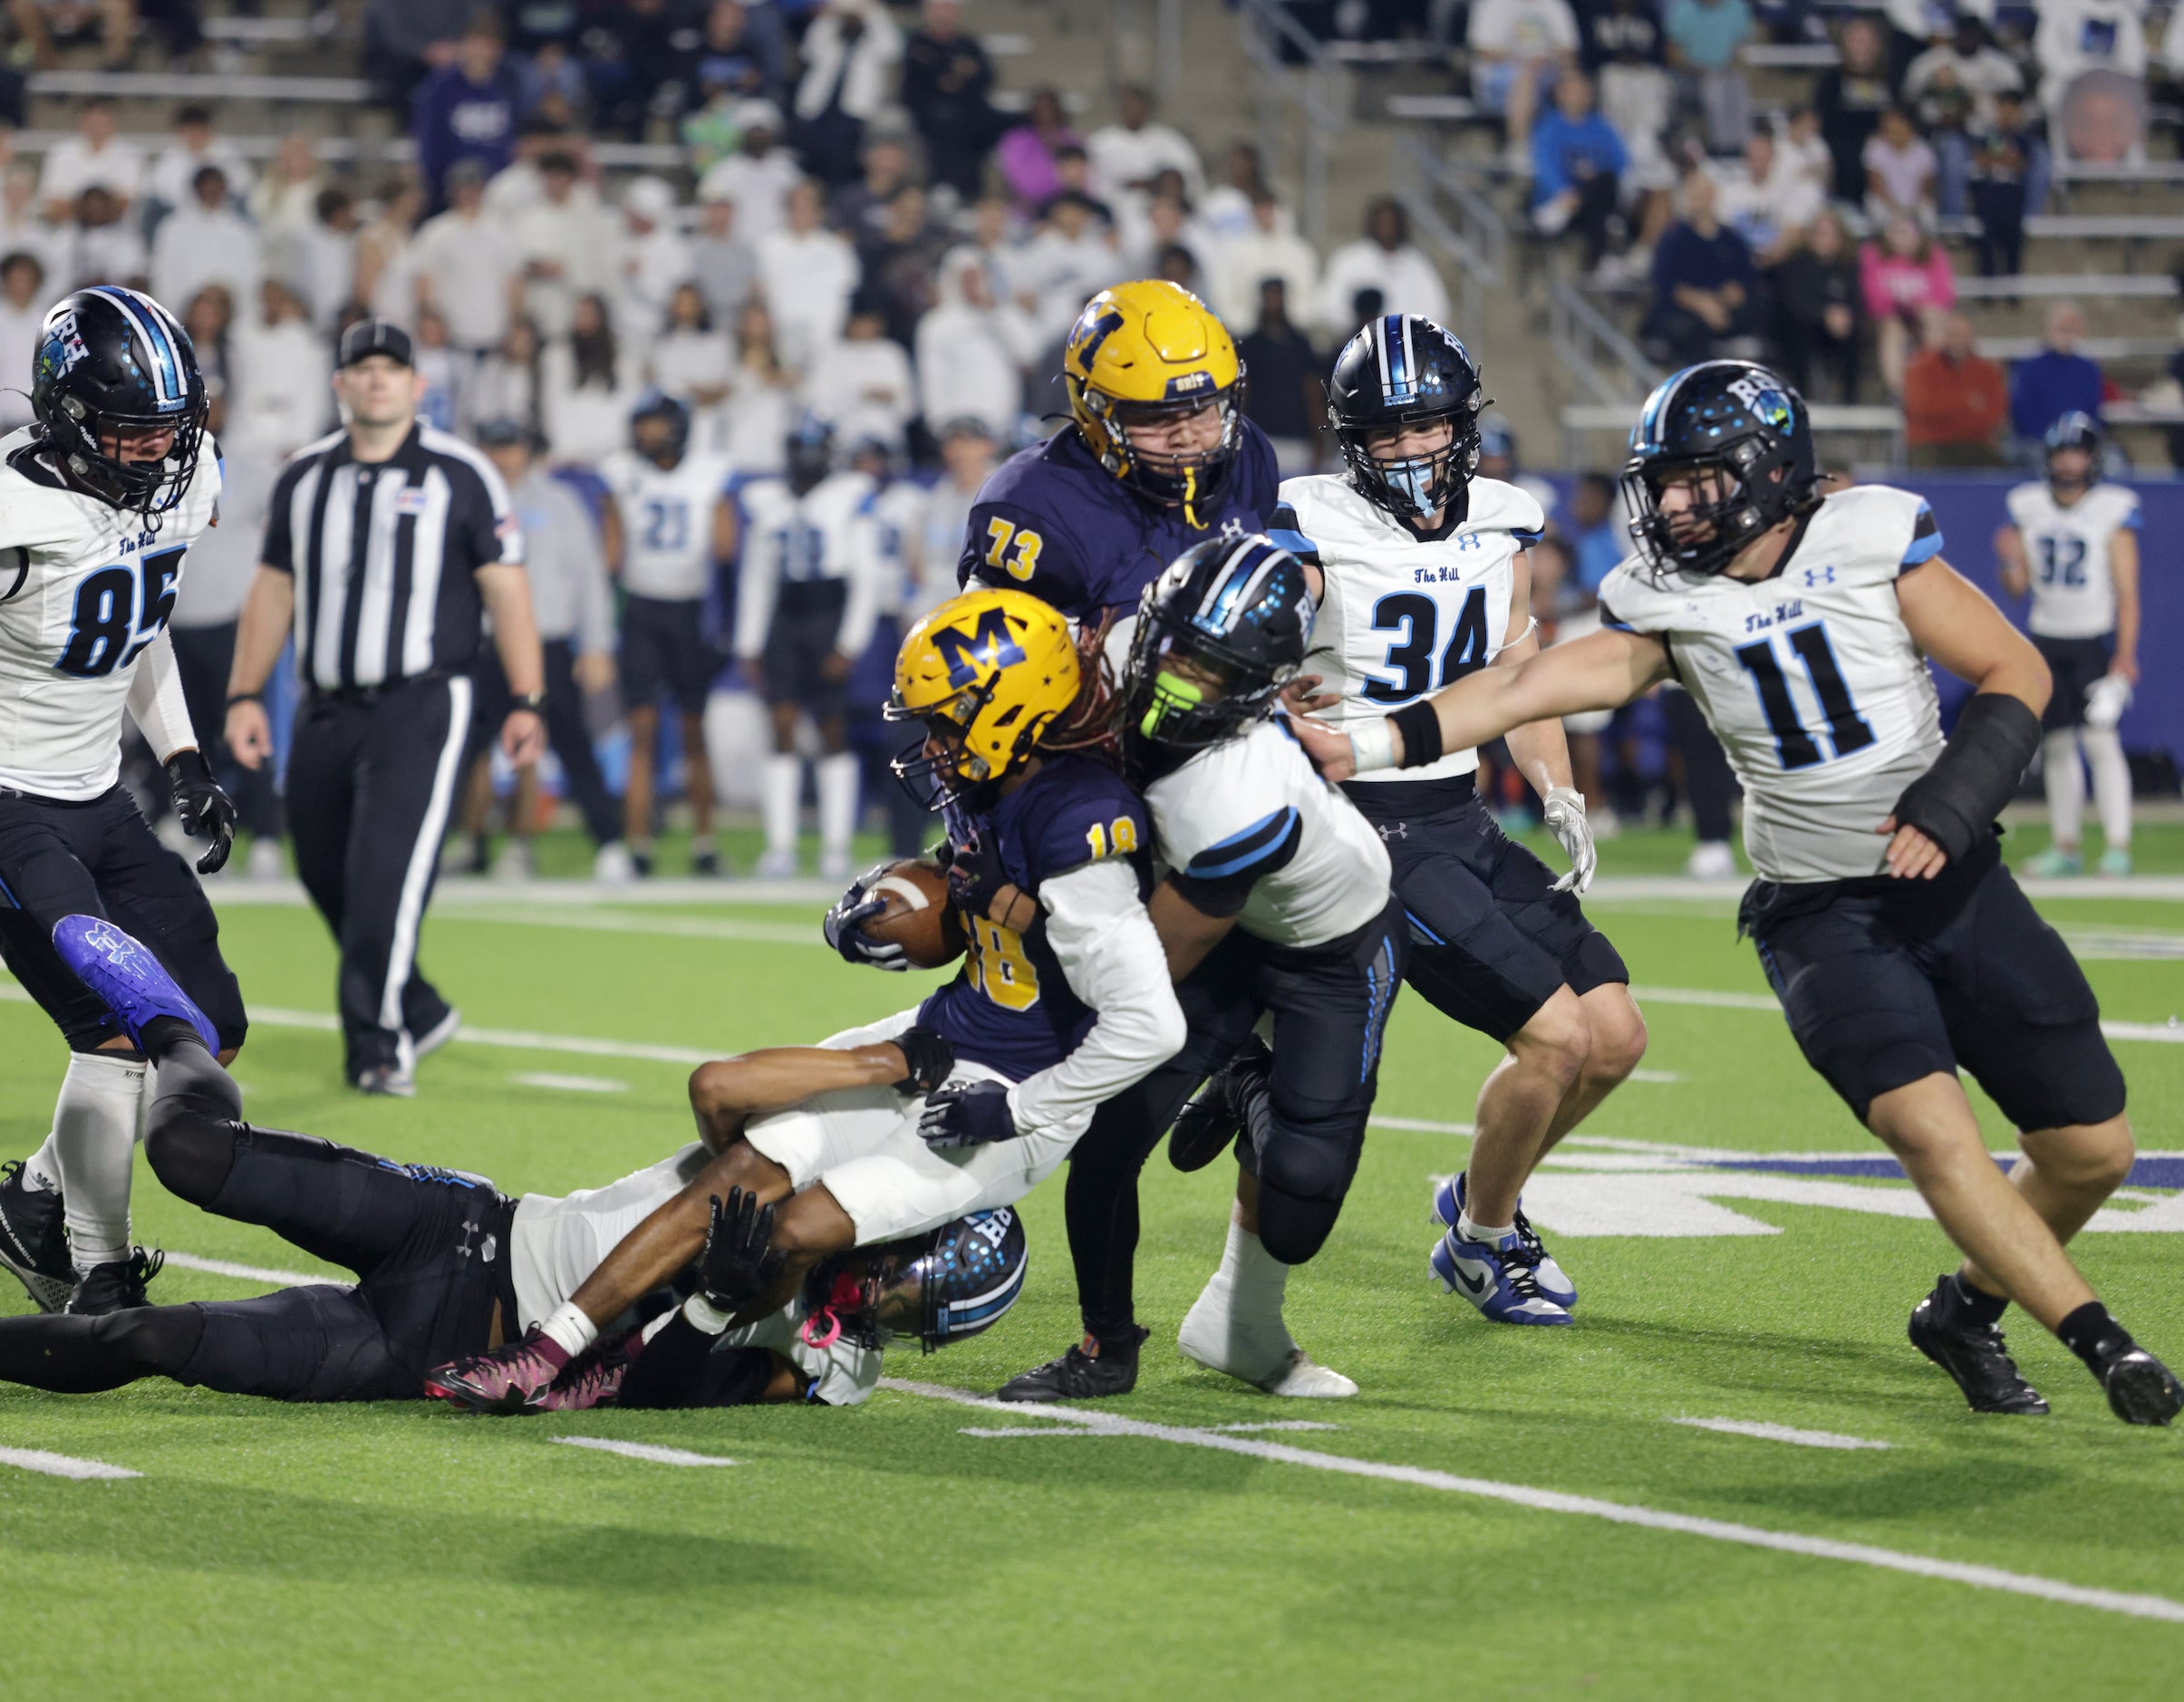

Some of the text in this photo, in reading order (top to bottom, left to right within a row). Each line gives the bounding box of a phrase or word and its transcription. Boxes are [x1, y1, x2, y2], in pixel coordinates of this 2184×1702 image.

[119, 537, 136, 556] The
[985, 516, 1043, 582] 73
[1415, 566, 1460, 583] The Hill
[54, 543, 188, 678] 85
[1745, 599, 1803, 633] The Hill
[931, 606, 1027, 691] M
[1360, 584, 1488, 705] 34
[1732, 618, 1879, 770] 11
[1086, 816, 1138, 859] 18
[10, 1233, 36, 1267] ARMOUR
